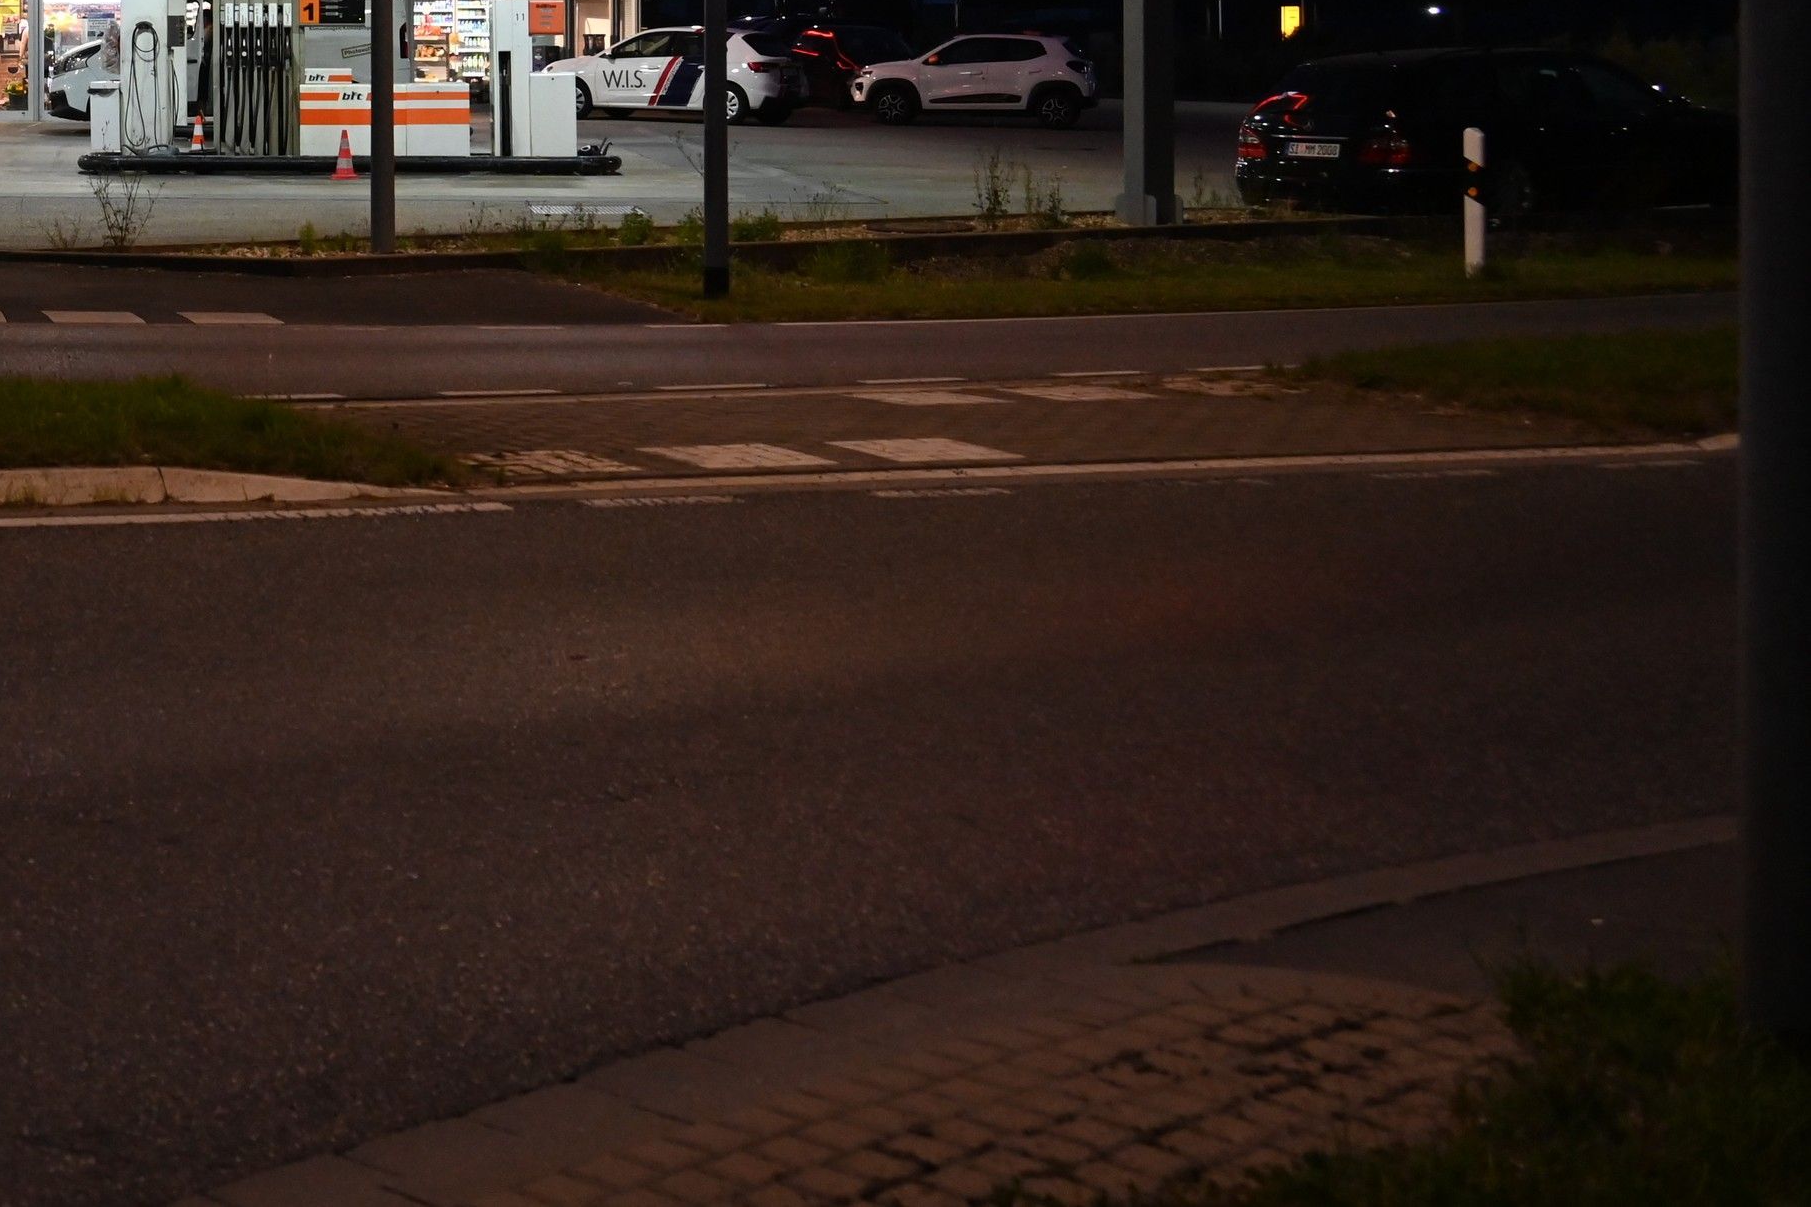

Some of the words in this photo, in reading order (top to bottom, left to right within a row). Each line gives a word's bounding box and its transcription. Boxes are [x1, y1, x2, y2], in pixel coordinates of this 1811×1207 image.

[303, 3, 314, 21] 1
[603, 69, 646, 89] W.I.S.
[342, 91, 364, 101] bft
